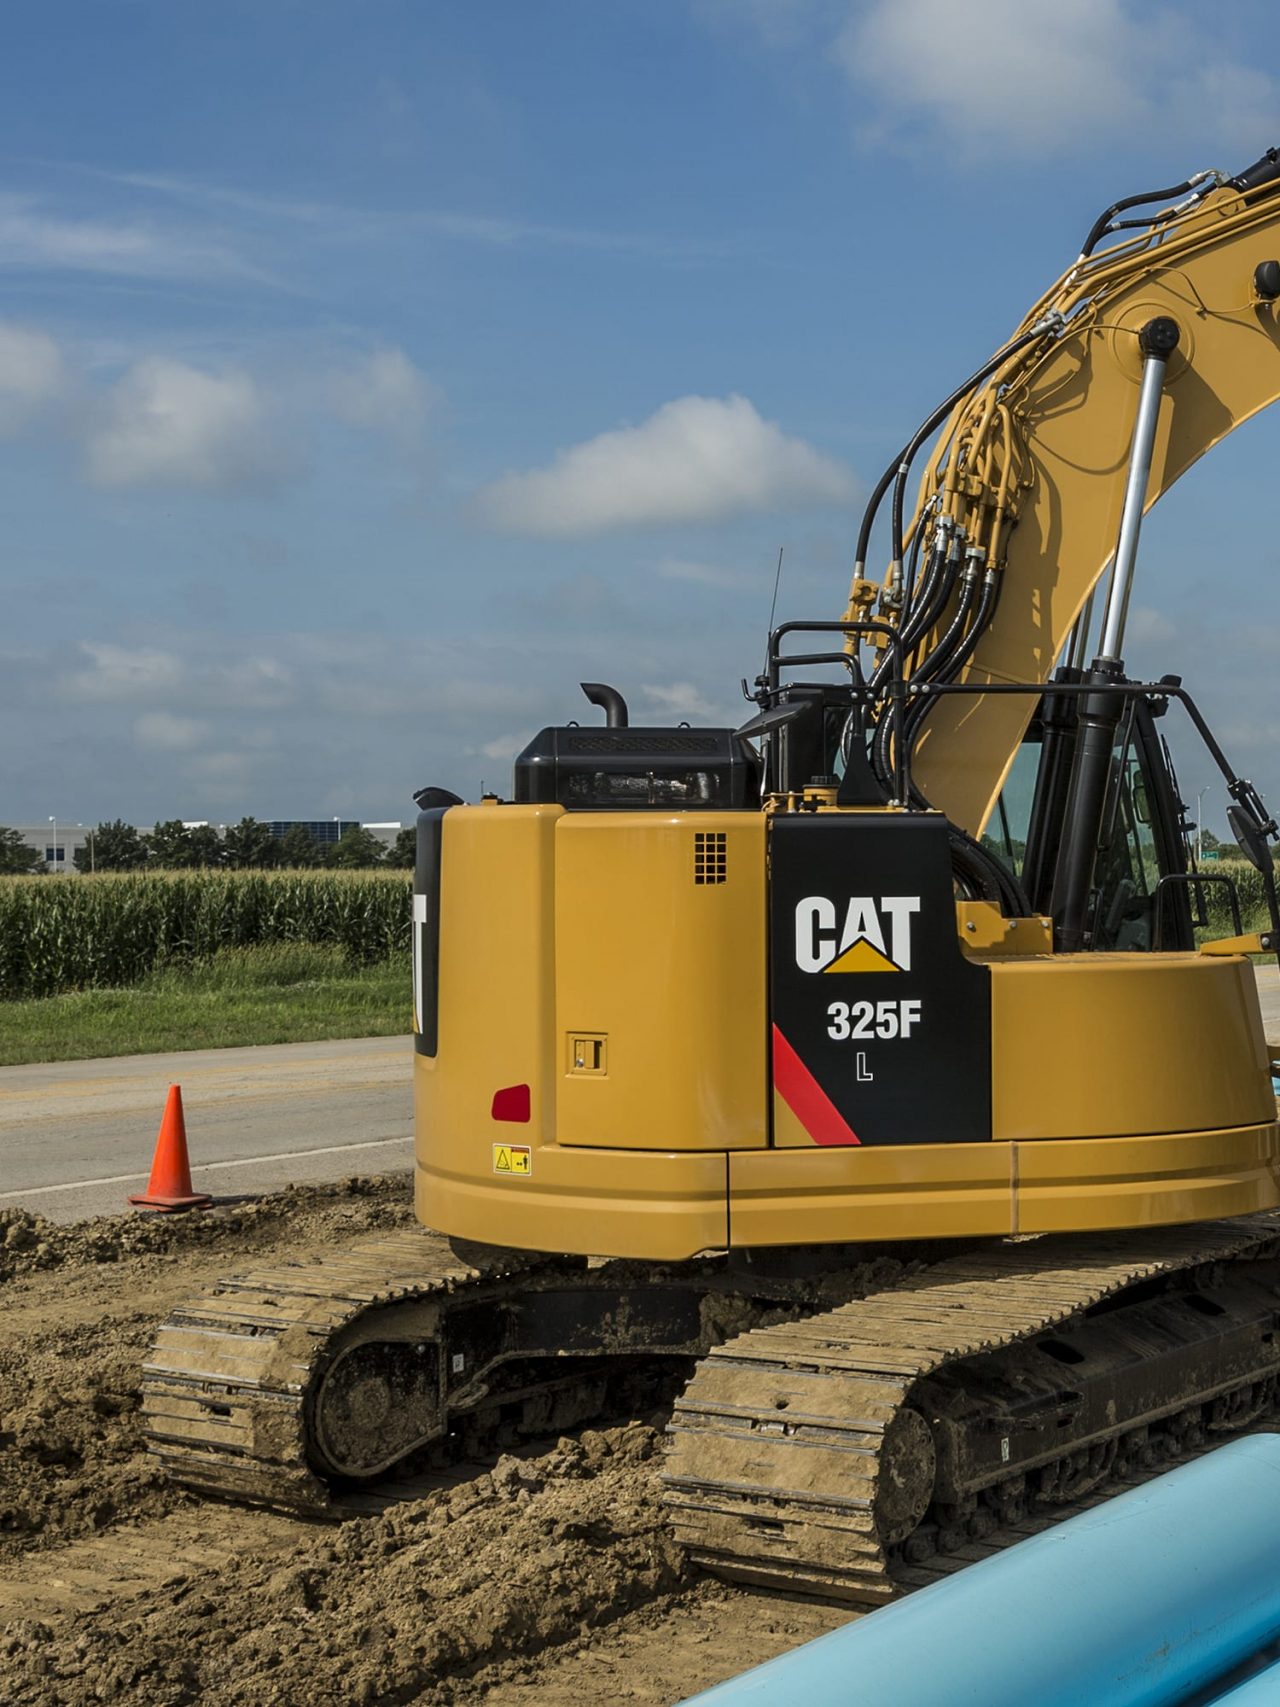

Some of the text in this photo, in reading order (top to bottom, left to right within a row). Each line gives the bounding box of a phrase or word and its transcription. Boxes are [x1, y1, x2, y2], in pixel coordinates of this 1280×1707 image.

[795, 896, 920, 973] CAT
[827, 1000, 922, 1040] 325F
[856, 1052, 873, 1081] L
